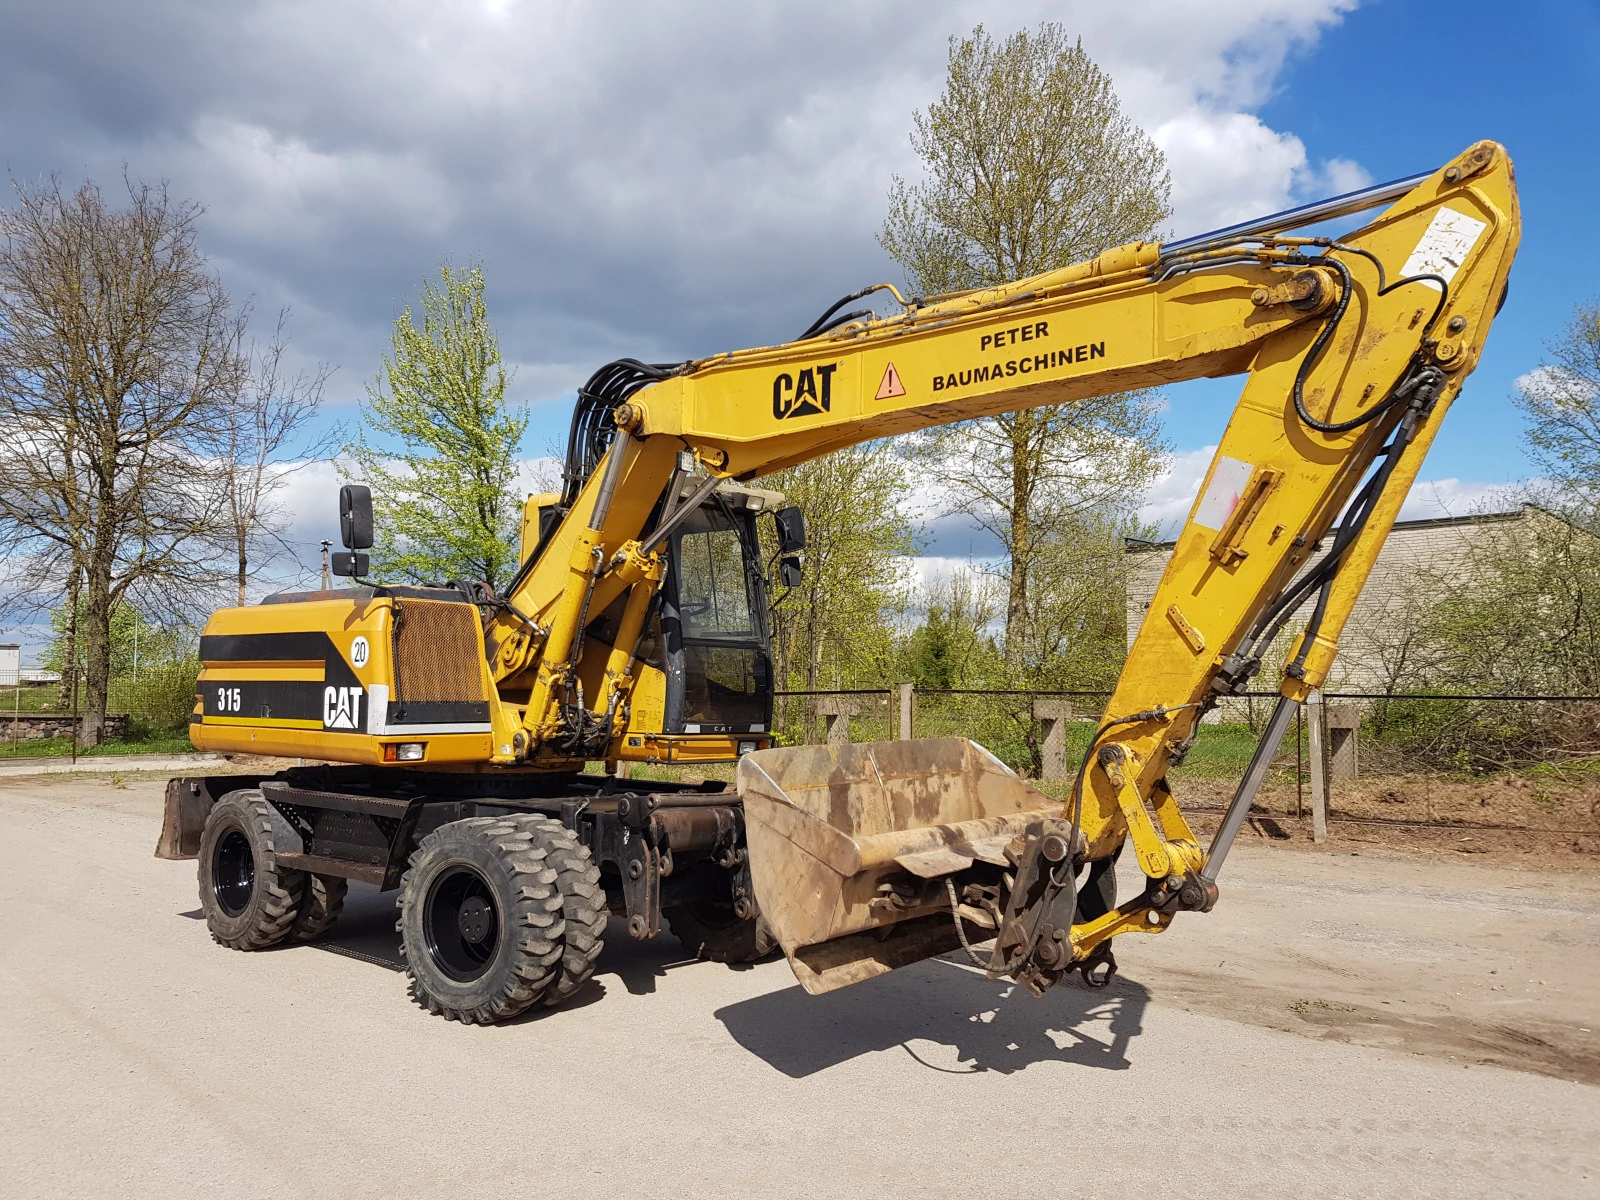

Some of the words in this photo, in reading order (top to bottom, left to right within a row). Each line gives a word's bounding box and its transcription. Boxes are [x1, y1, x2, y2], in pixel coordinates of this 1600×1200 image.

[980, 321, 1050, 351] PETER
[932, 341, 1106, 392] BAUMASCHINEN
[773, 362, 837, 420] CAT
[354, 641, 366, 663] 20
[217, 687, 241, 712] 315
[323, 685, 364, 729] CAT
